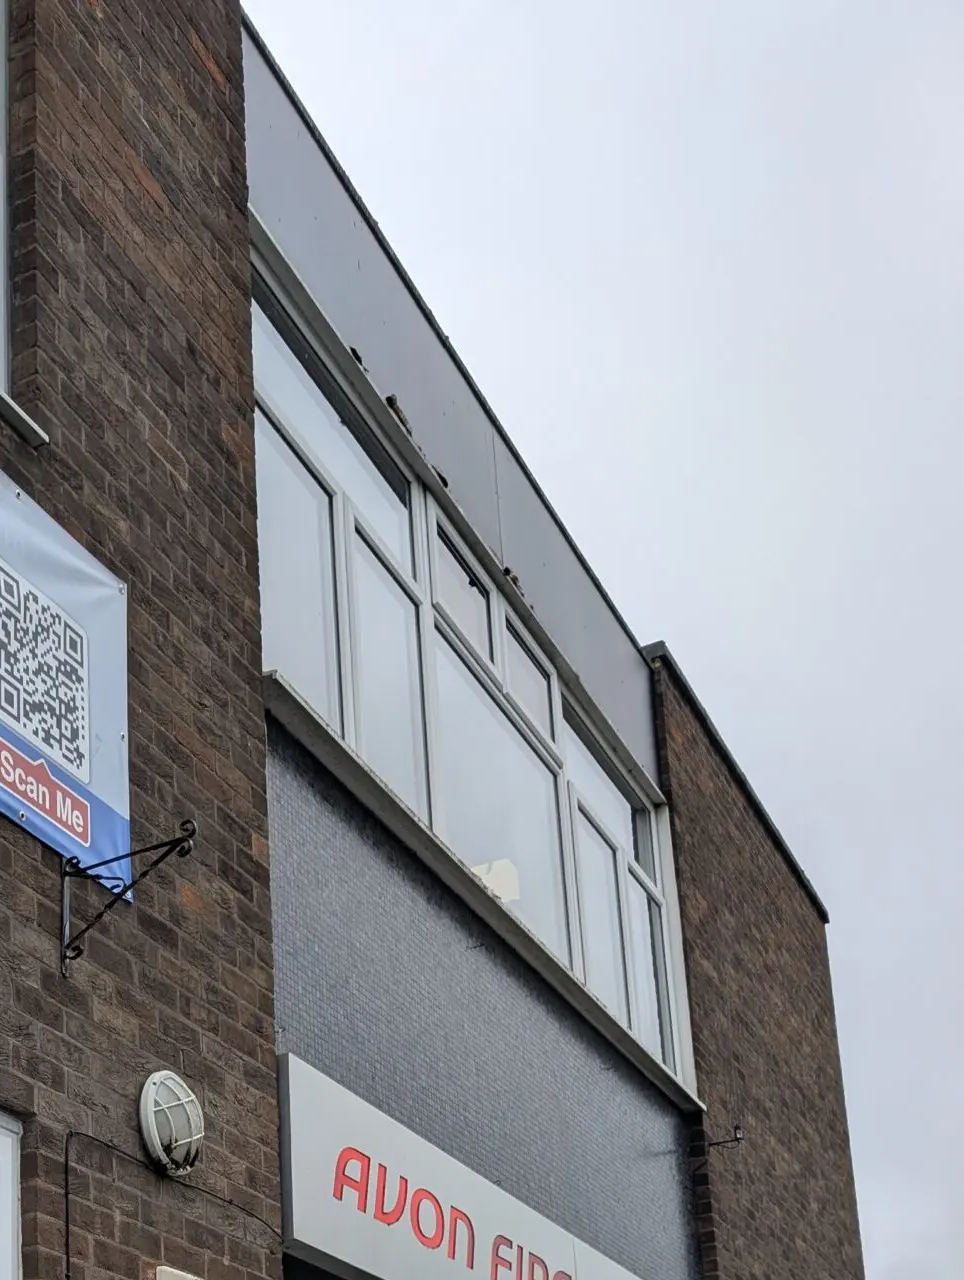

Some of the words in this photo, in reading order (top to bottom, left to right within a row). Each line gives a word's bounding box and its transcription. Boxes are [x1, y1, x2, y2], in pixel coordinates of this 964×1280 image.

[0, 751, 50, 811] Scan
[57, 791, 85, 834] Me
[332, 1146, 475, 1270] AVON
